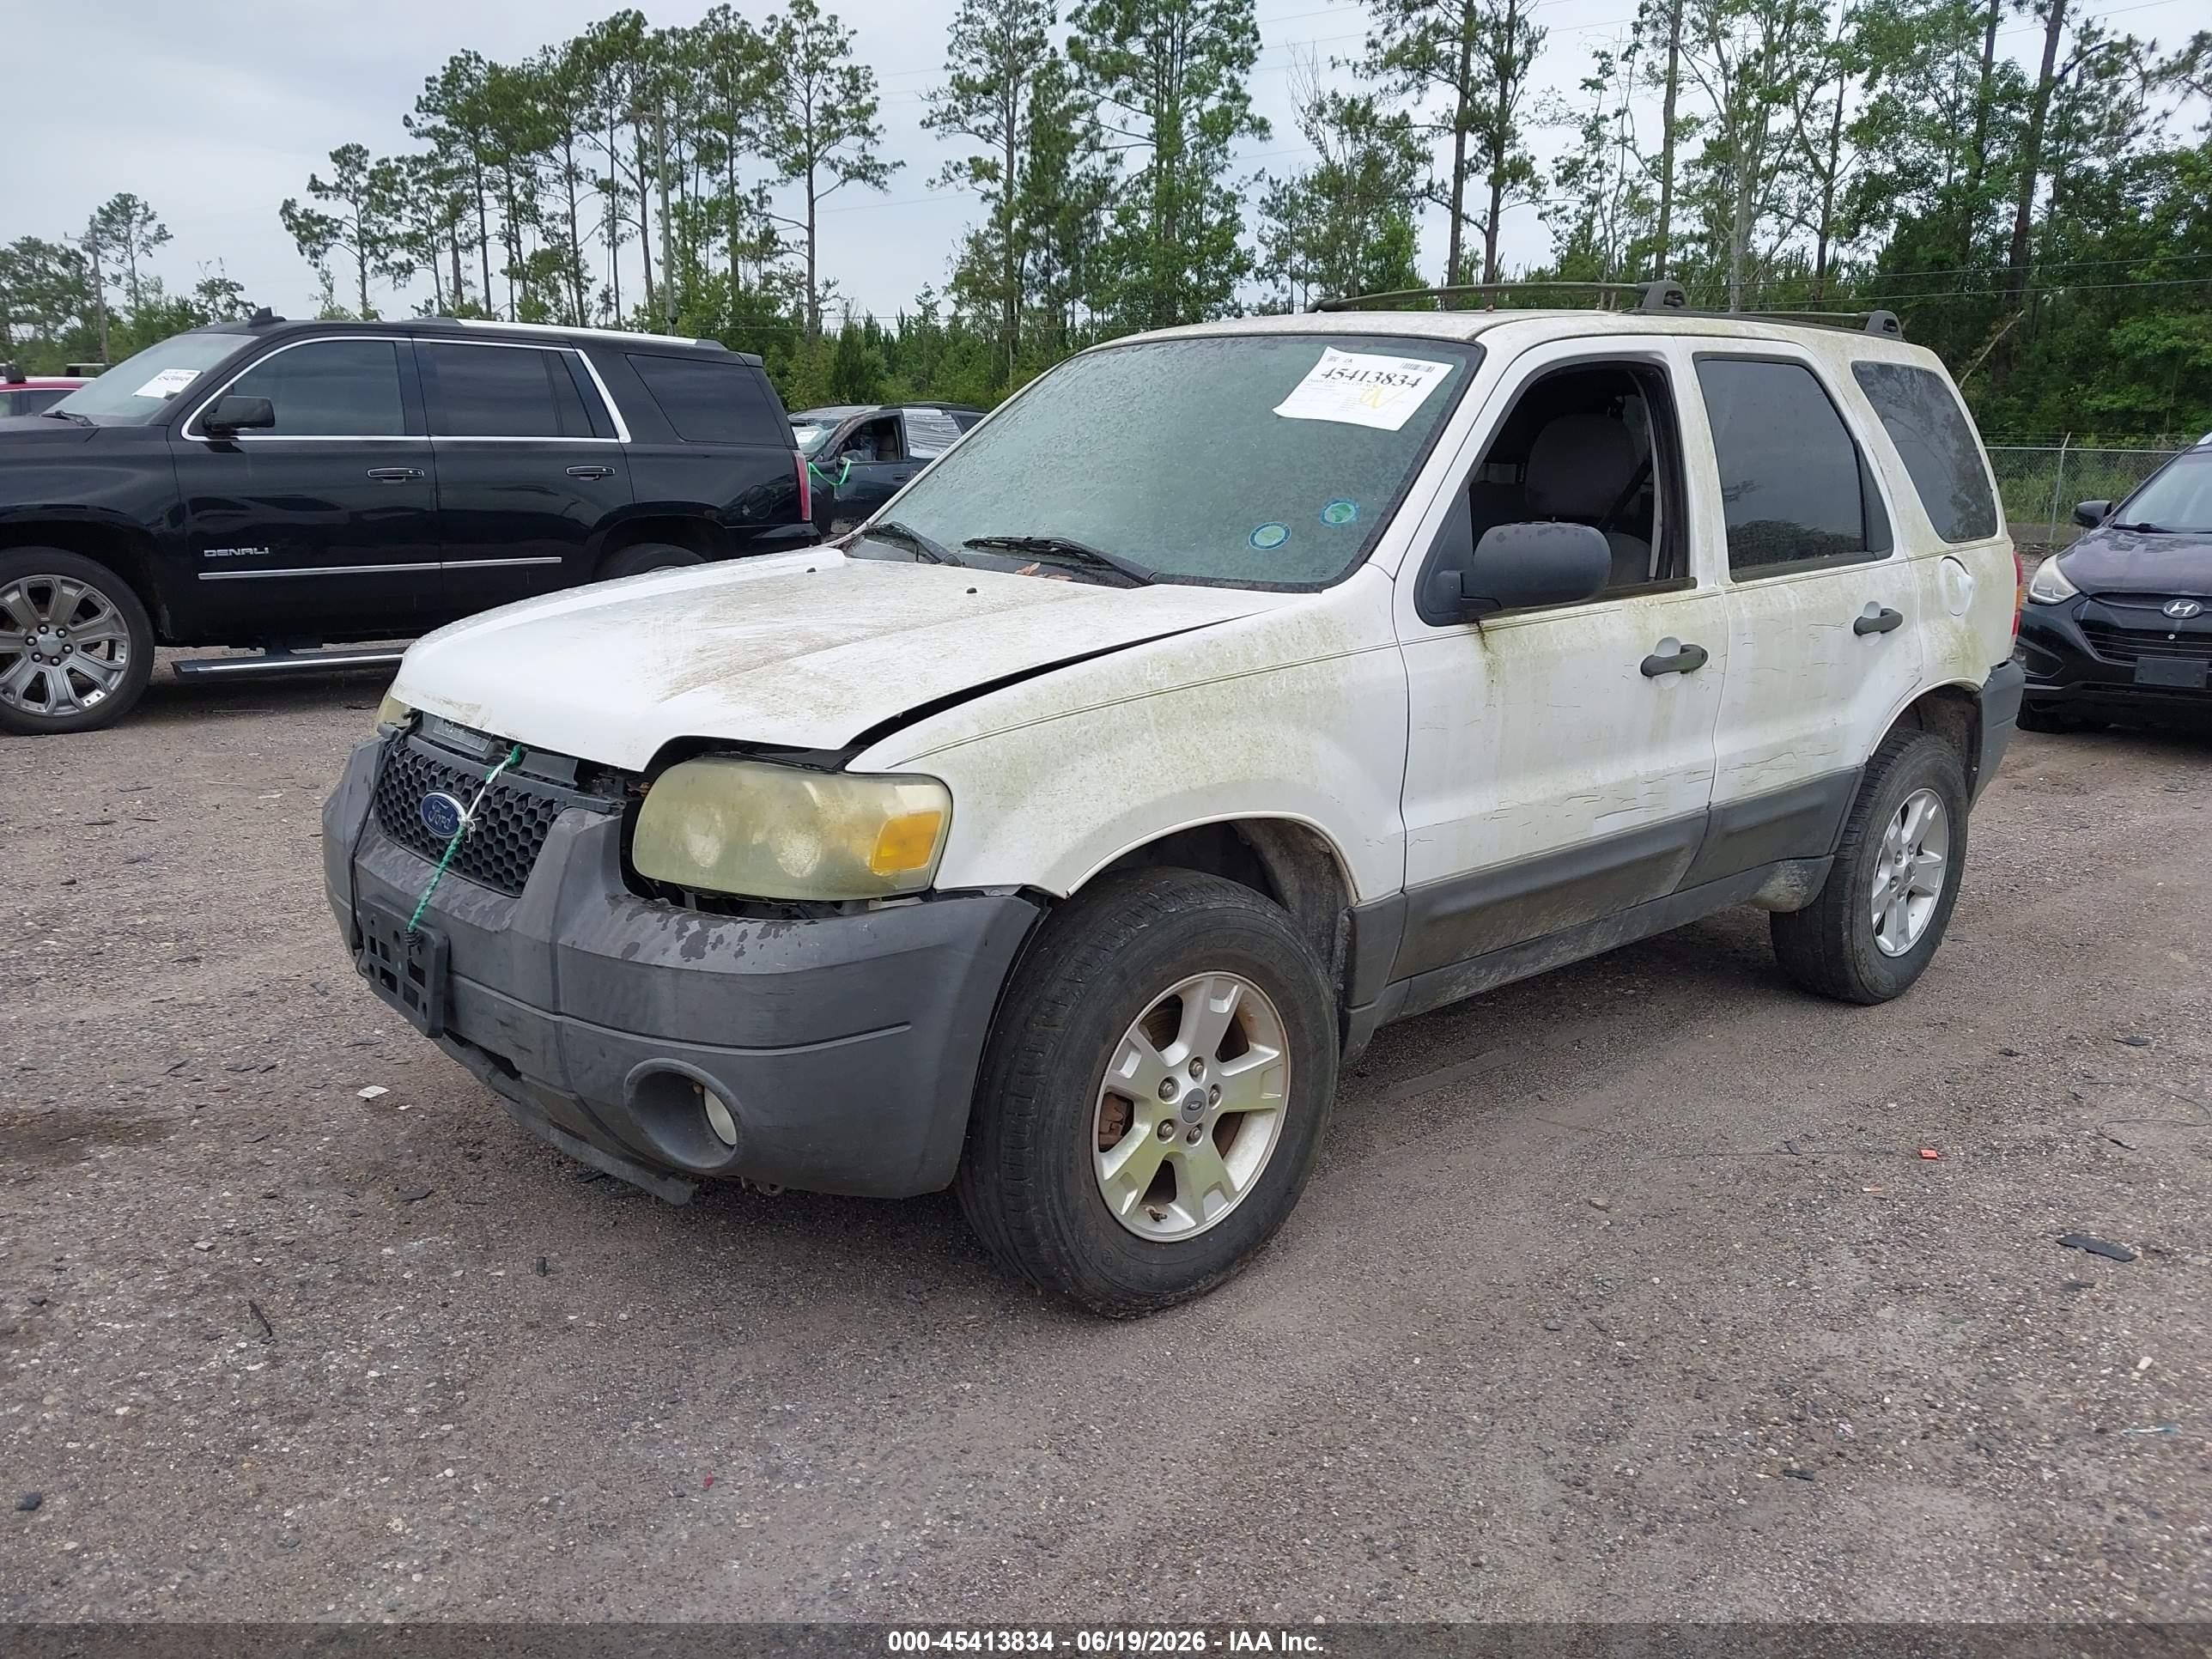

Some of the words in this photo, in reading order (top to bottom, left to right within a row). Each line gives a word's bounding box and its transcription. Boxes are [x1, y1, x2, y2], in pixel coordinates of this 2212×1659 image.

[1322, 367, 1422, 388] 45413834
[204, 547, 270, 557] DENALI
[428, 799, 454, 830] Ford
